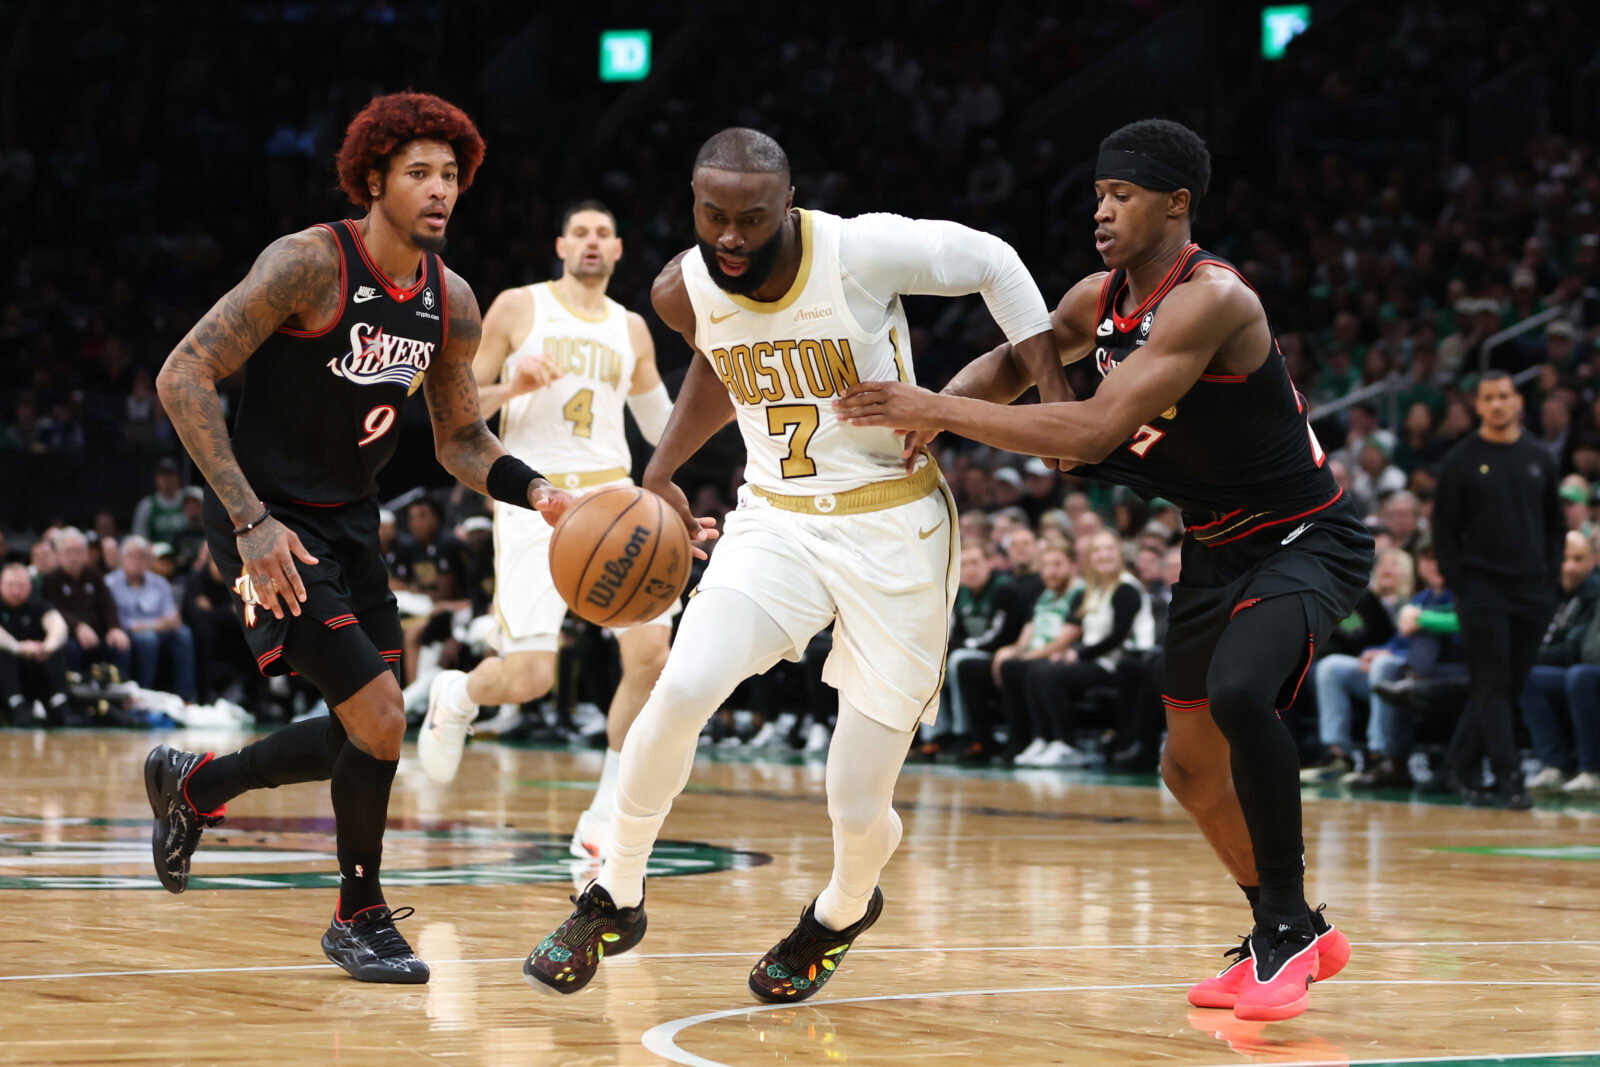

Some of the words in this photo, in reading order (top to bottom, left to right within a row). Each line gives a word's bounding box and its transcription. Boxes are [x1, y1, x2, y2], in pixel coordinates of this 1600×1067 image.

[415, 310, 440, 321] crypto.com
[794, 307, 833, 322] Amica
[711, 339, 861, 405] BOSTON
[358, 404, 397, 447] 9
[562, 387, 595, 439] 4
[766, 403, 820, 479] 7
[586, 525, 651, 609] Wilson
